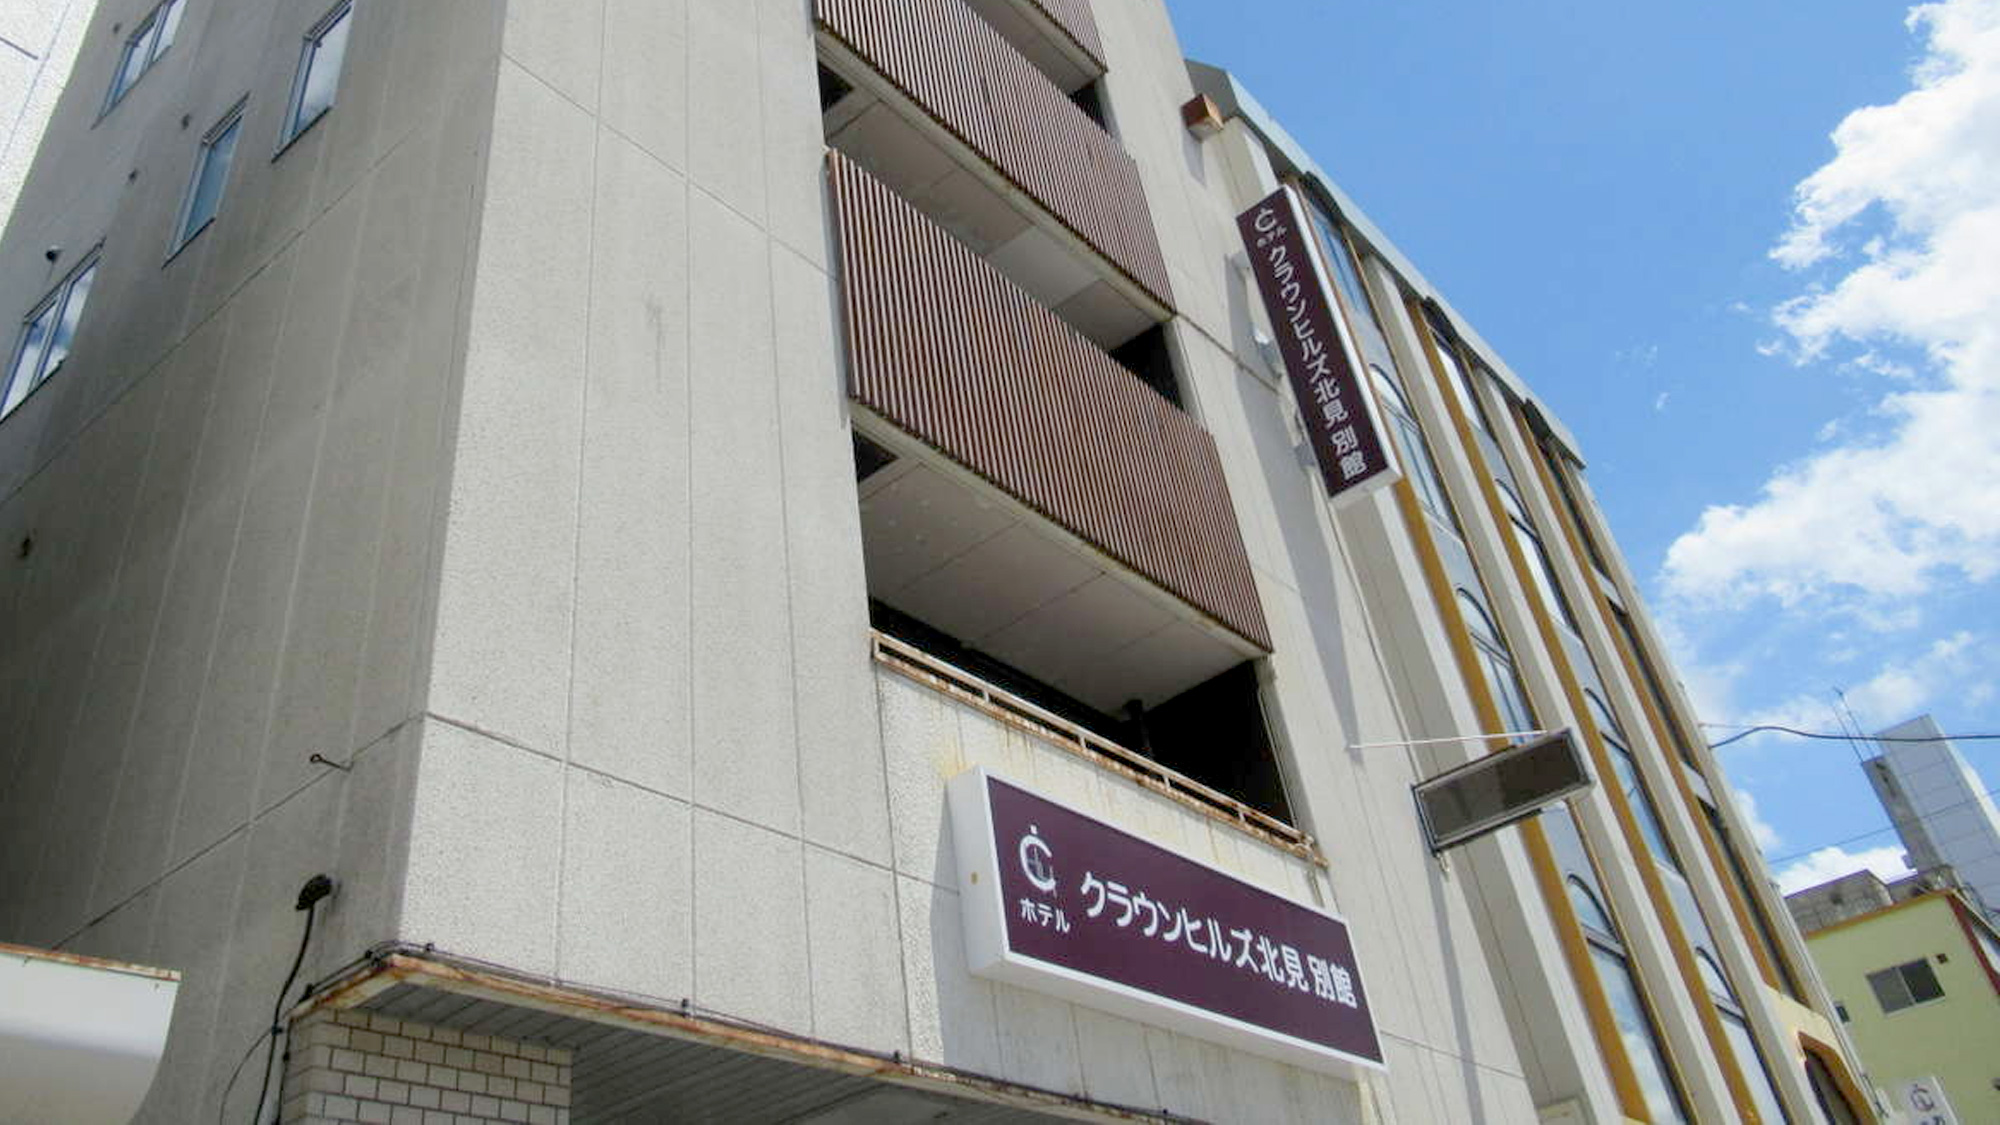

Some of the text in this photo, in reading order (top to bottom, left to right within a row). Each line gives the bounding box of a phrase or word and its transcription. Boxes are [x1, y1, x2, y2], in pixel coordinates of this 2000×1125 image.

[1268, 244, 1349, 429] クラウンヒルズ北見
[1020, 897, 1071, 935] ホテル
[1081, 871, 1358, 1009] クラウンヒルズ北見 別館
